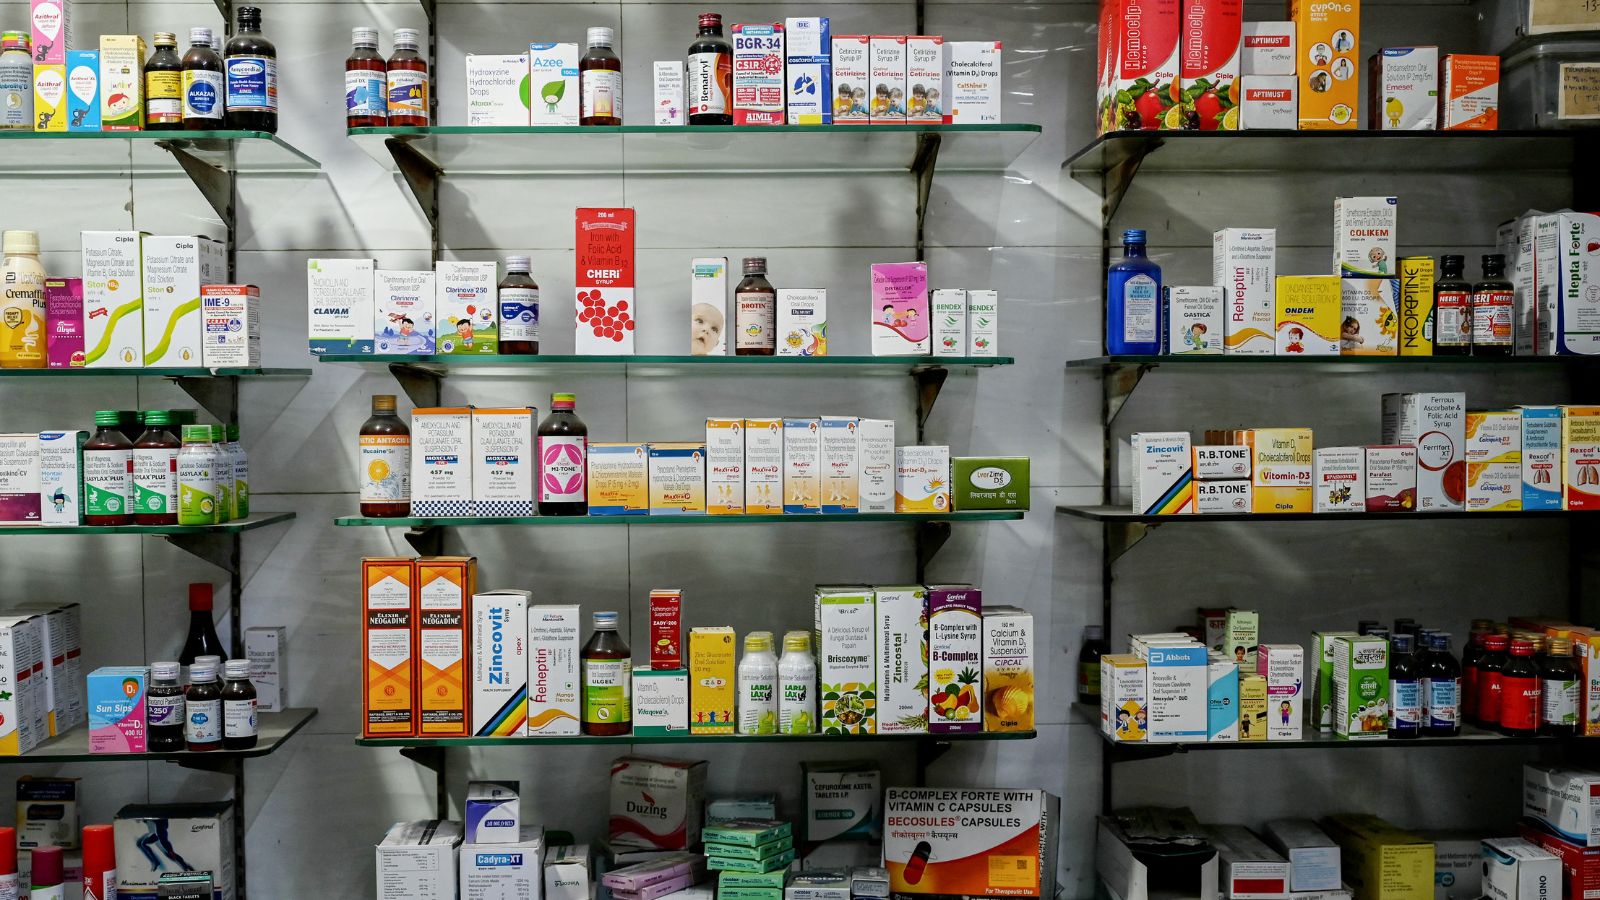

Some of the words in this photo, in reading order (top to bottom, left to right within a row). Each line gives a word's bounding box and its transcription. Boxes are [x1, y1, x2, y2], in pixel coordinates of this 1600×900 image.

[736, 38, 781, 49] BGR-34
[533, 56, 563, 67] Azee
[470, 68, 510, 77] Hydroxyzine
[981, 70, 998, 78] Drops
[470, 78, 516, 86] Hydrochloride
[700, 58, 708, 102] Benadryl
[470, 88, 490, 97] Drops
[746, 113, 772, 121] AIMIL
[590, 232, 602, 242] Iron
[604, 232, 620, 242] with
[588, 244, 604, 254] Folic
[605, 244, 622, 254] Acid
[588, 256, 614, 266] Vitamin
[1568, 257, 1581, 299] Hepta
[1232, 267, 1245, 322] Reheptin
[204, 298, 230, 306] IME-9
[314, 308, 349, 316] CLAVAM
[1146, 446, 1184, 454] Zincovit
[1199, 450, 1246, 458] R.B.TONE
[1199, 485, 1246, 494] R.B.TONE
[936, 632, 958, 640] L-Lysine
[959, 632, 976, 640] Syrup
[990, 630, 1018, 638] Calcium
[490, 607, 502, 685] Zincovit
[992, 638, 1018, 646] Vitamin
[990, 647, 1026, 655] Suspension
[828, 655, 868, 664] Briscozyme
[894, 632, 902, 684] Zincostal
[932, 651, 978, 662] B-Complex
[535, 648, 547, 703] Reheptin
[114, 704, 132, 714] Sips
[889, 791, 958, 800] B-COMPLEX
[960, 792, 1000, 801] FORTE
[1004, 792, 1033, 802] WITH
[626, 801, 667, 819] Duzing
[888, 802, 934, 812] VITAMIN
[938, 802, 946, 812] C
[949, 803, 1012, 812] CAPSULES
[961, 818, 1020, 828] CAPSULES
[478, 855, 521, 864] Cadyra-XT
